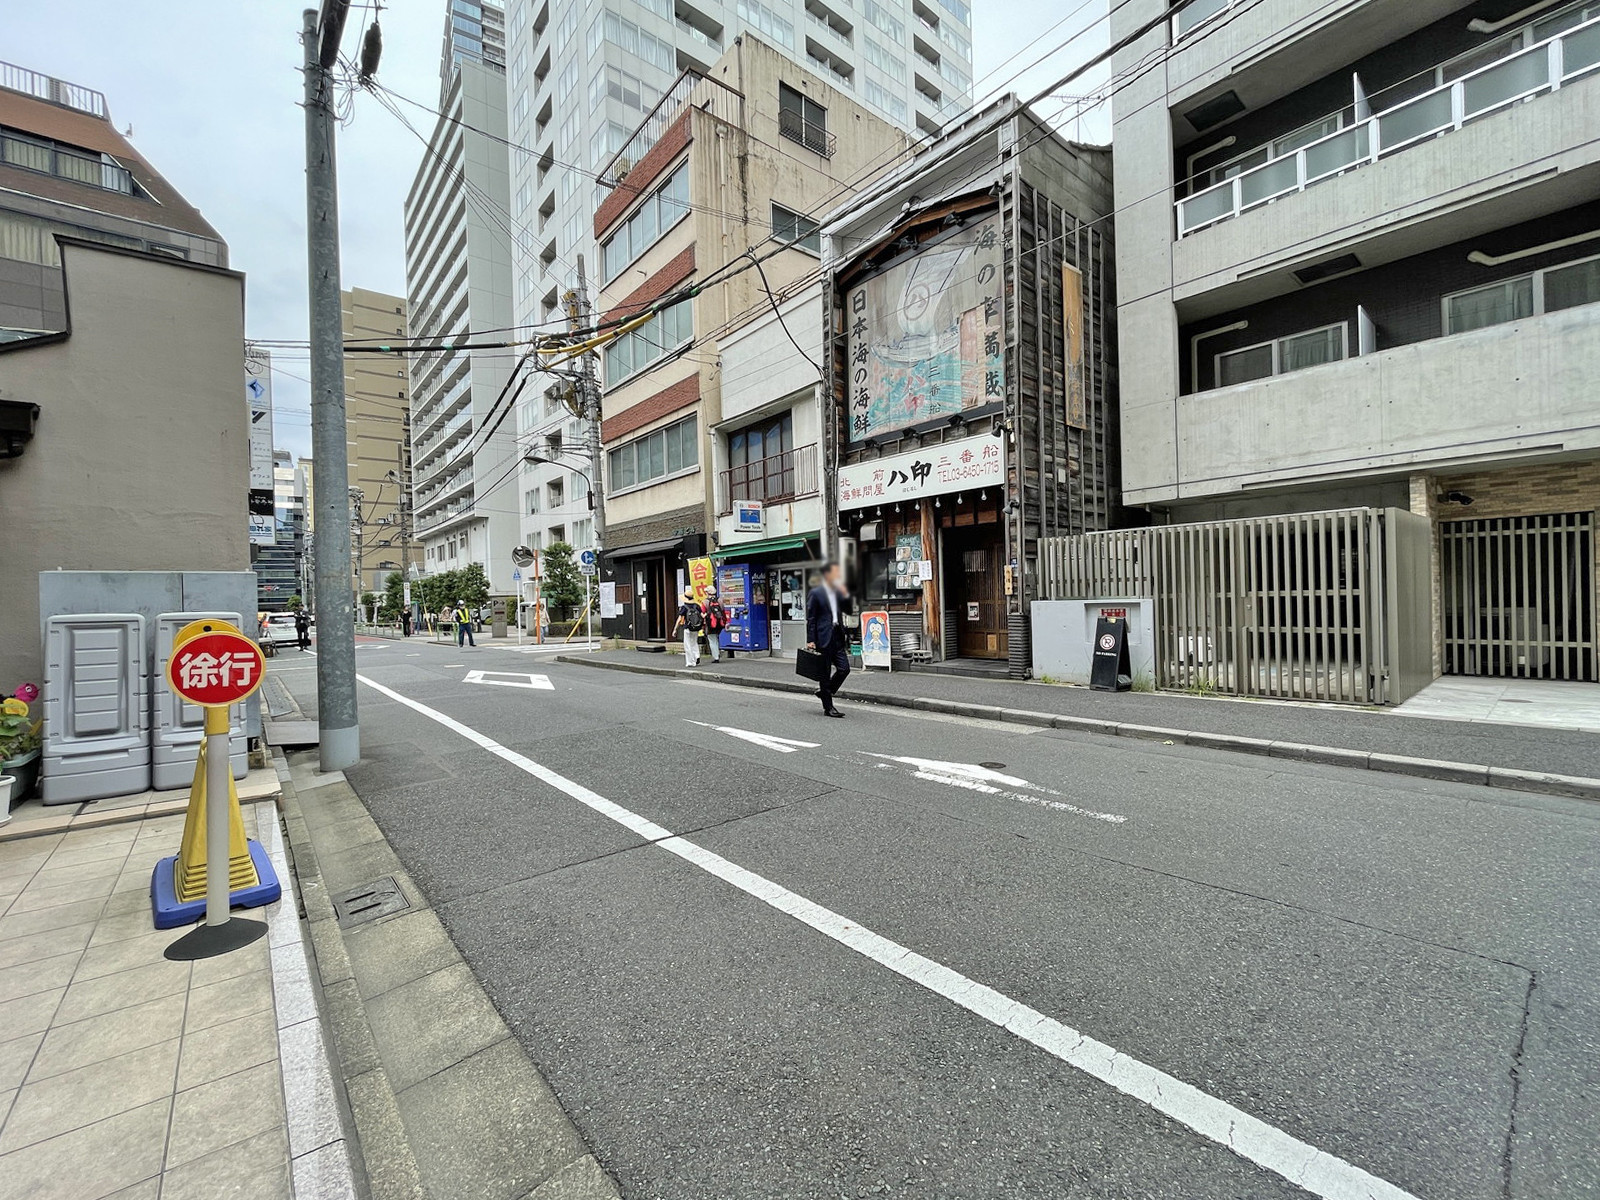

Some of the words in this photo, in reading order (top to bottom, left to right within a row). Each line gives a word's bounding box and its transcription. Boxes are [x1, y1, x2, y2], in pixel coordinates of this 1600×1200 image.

[851, 289, 872, 436] 日本海の海鮮
[937, 444, 999, 468] 三番船
[887, 460, 932, 487] 八印
[840, 483, 885, 502] 海鮮問屋
[179, 652, 256, 690] 徐行
